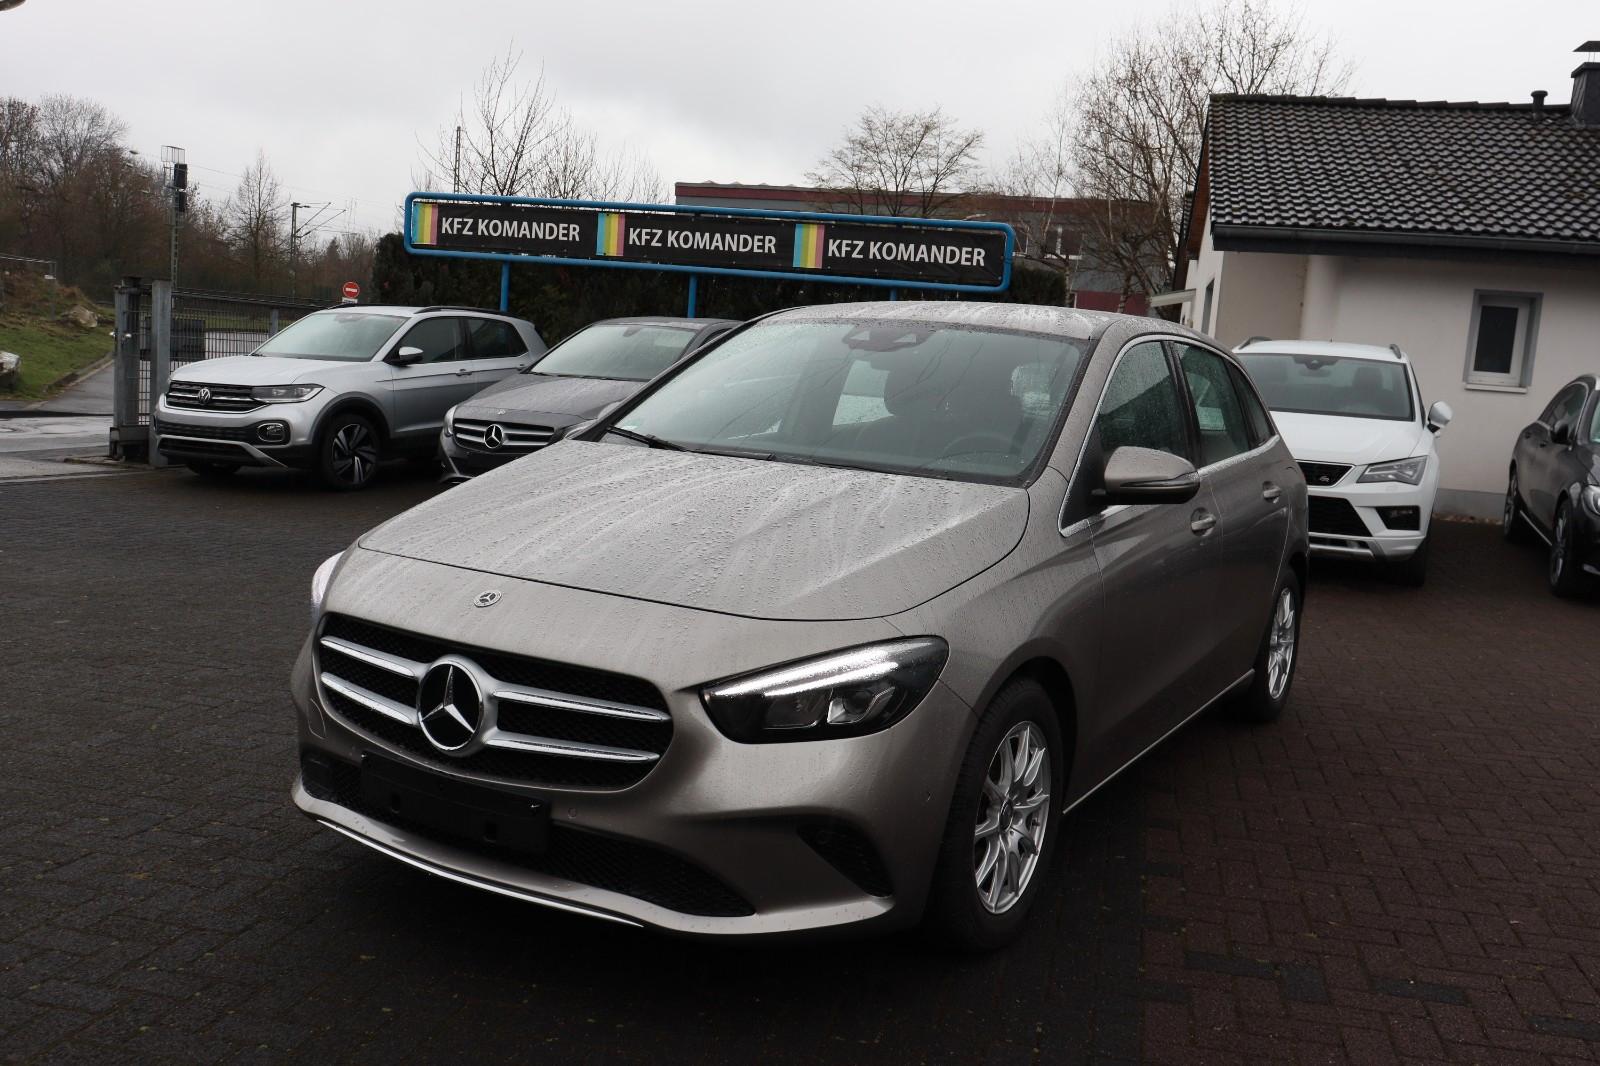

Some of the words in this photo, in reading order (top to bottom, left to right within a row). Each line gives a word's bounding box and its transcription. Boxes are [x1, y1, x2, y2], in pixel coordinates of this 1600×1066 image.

[441, 217, 474, 236] KFZ
[477, 218, 580, 242] KOMANDER
[628, 227, 663, 247] KFZ
[667, 230, 777, 254] KOMANDER
[828, 238, 865, 259] KFZ
[869, 241, 986, 267] KOMANDER
